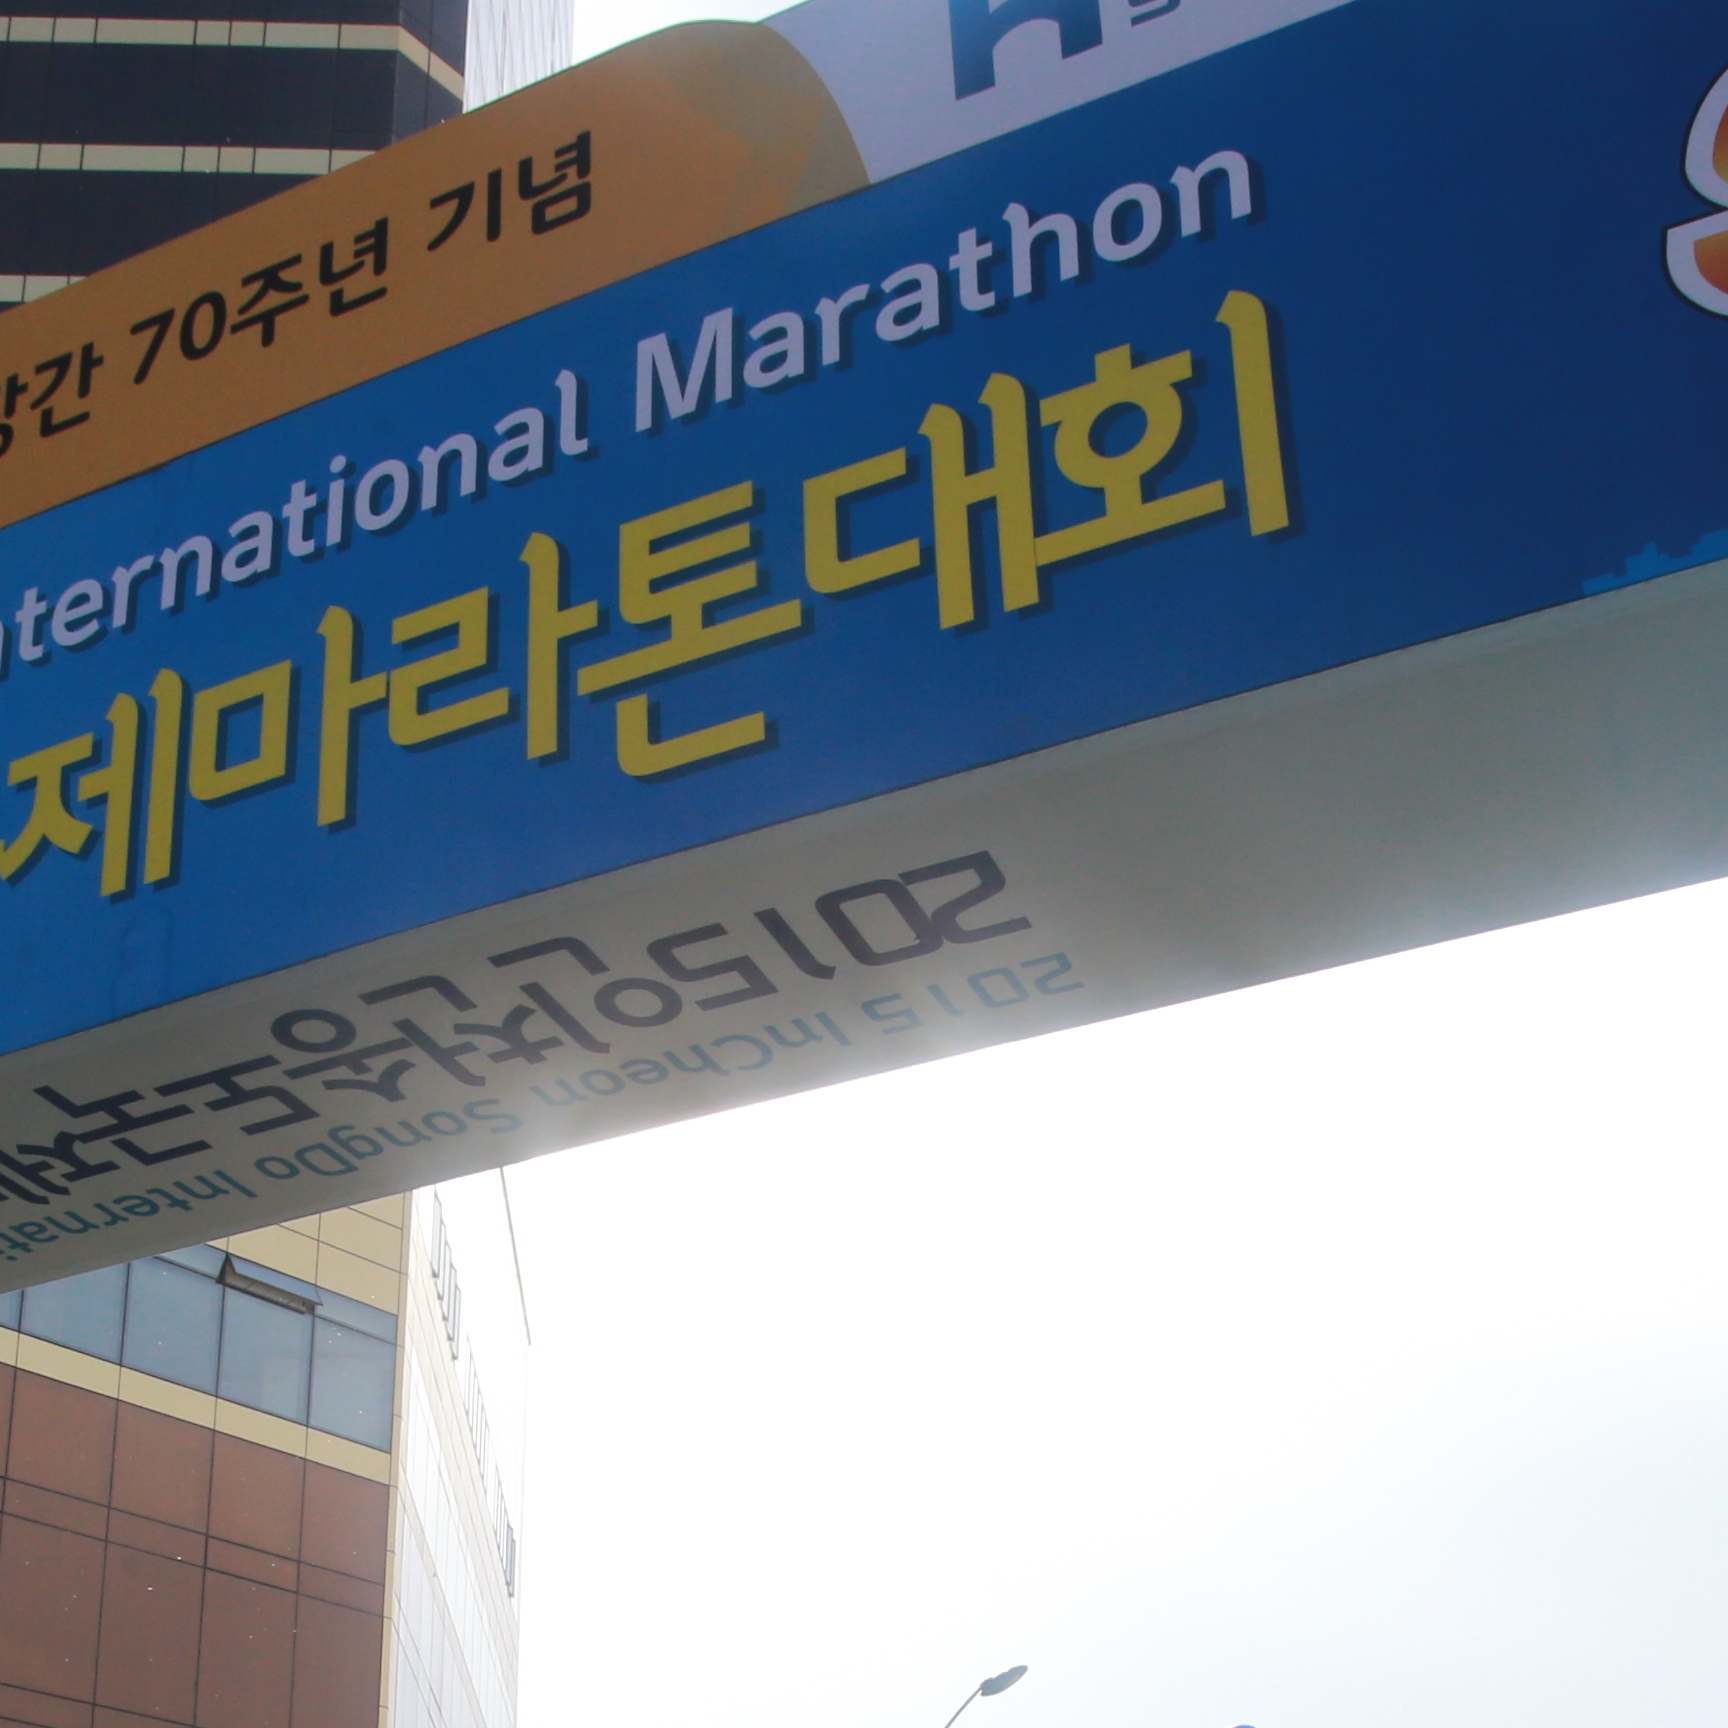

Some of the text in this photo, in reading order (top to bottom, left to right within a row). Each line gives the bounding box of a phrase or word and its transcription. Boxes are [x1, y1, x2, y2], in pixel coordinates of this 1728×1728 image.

[130, 216, 390, 389] 70주년
[425, 131, 595, 250] 기념
[635, 148, 1254, 434] Marathon
[861, 954, 1085, 1037] 2015
[533, 1023, 848, 1109] InCheon
[254, 1099, 522, 1183] SongDo
